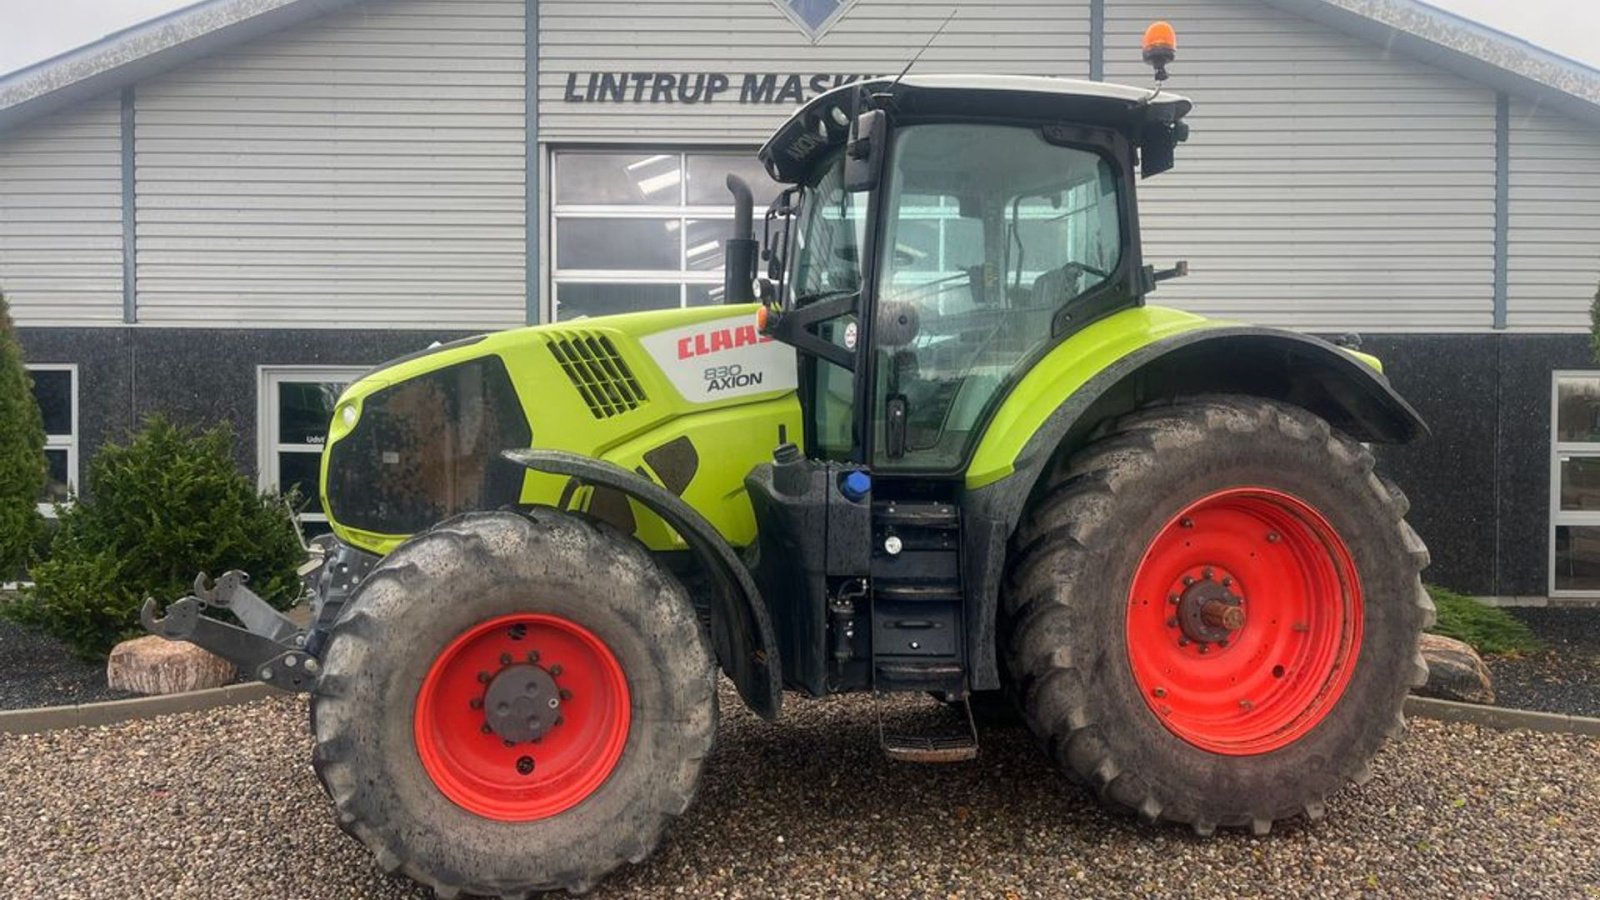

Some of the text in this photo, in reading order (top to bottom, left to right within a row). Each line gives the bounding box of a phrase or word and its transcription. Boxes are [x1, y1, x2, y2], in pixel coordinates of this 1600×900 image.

[565, 72, 729, 104] LINTRUP
[704, 364, 742, 381] 830
[707, 372, 763, 392] AXION
